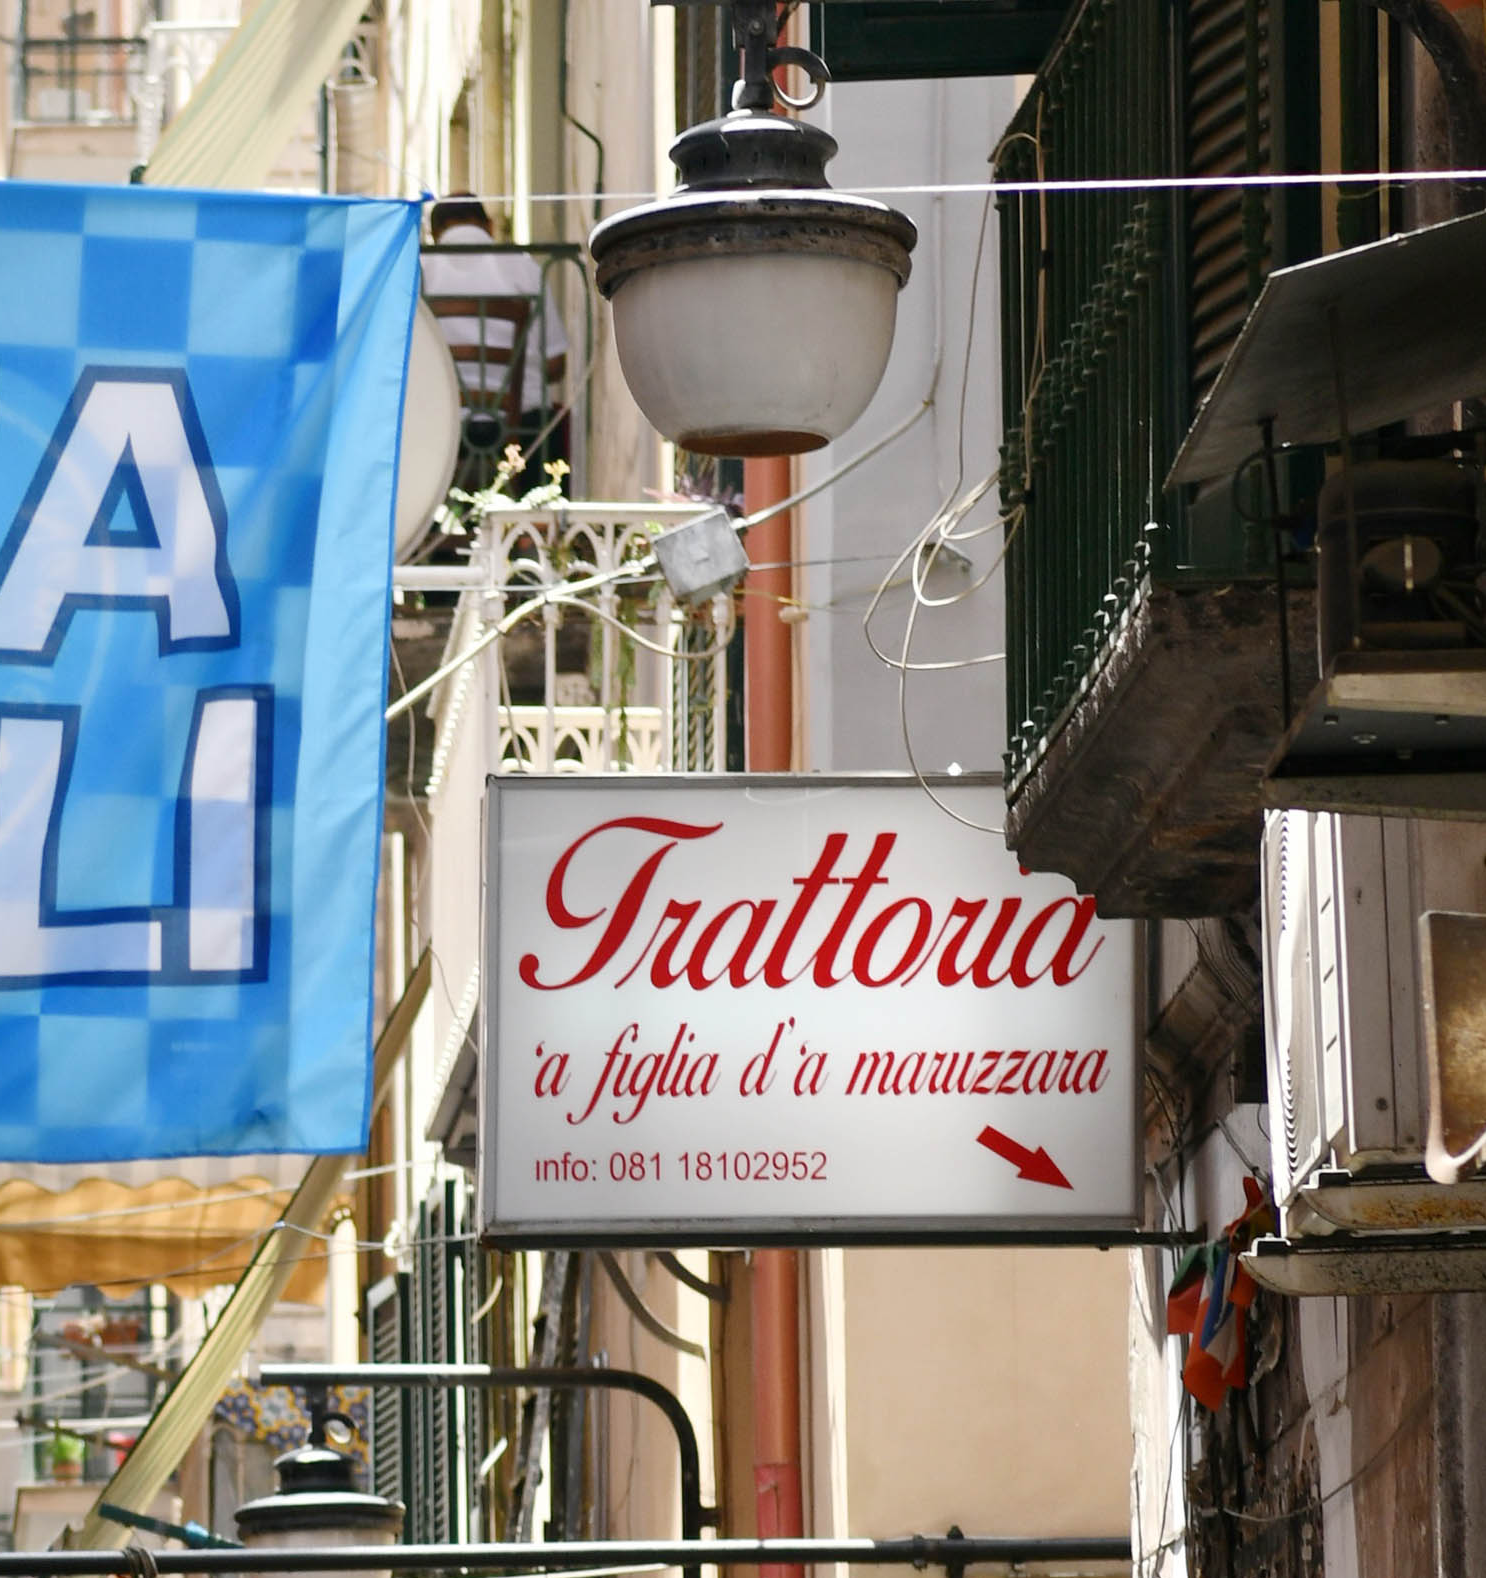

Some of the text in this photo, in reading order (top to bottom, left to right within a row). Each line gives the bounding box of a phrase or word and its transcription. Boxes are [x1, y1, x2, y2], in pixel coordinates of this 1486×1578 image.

[518, 815, 1106, 991] Trattoria
[566, 1022, 720, 1125] figlia
[845, 1047, 1111, 1096] maruzzara
[535, 1151, 829, 1183] info: 081 18102952
